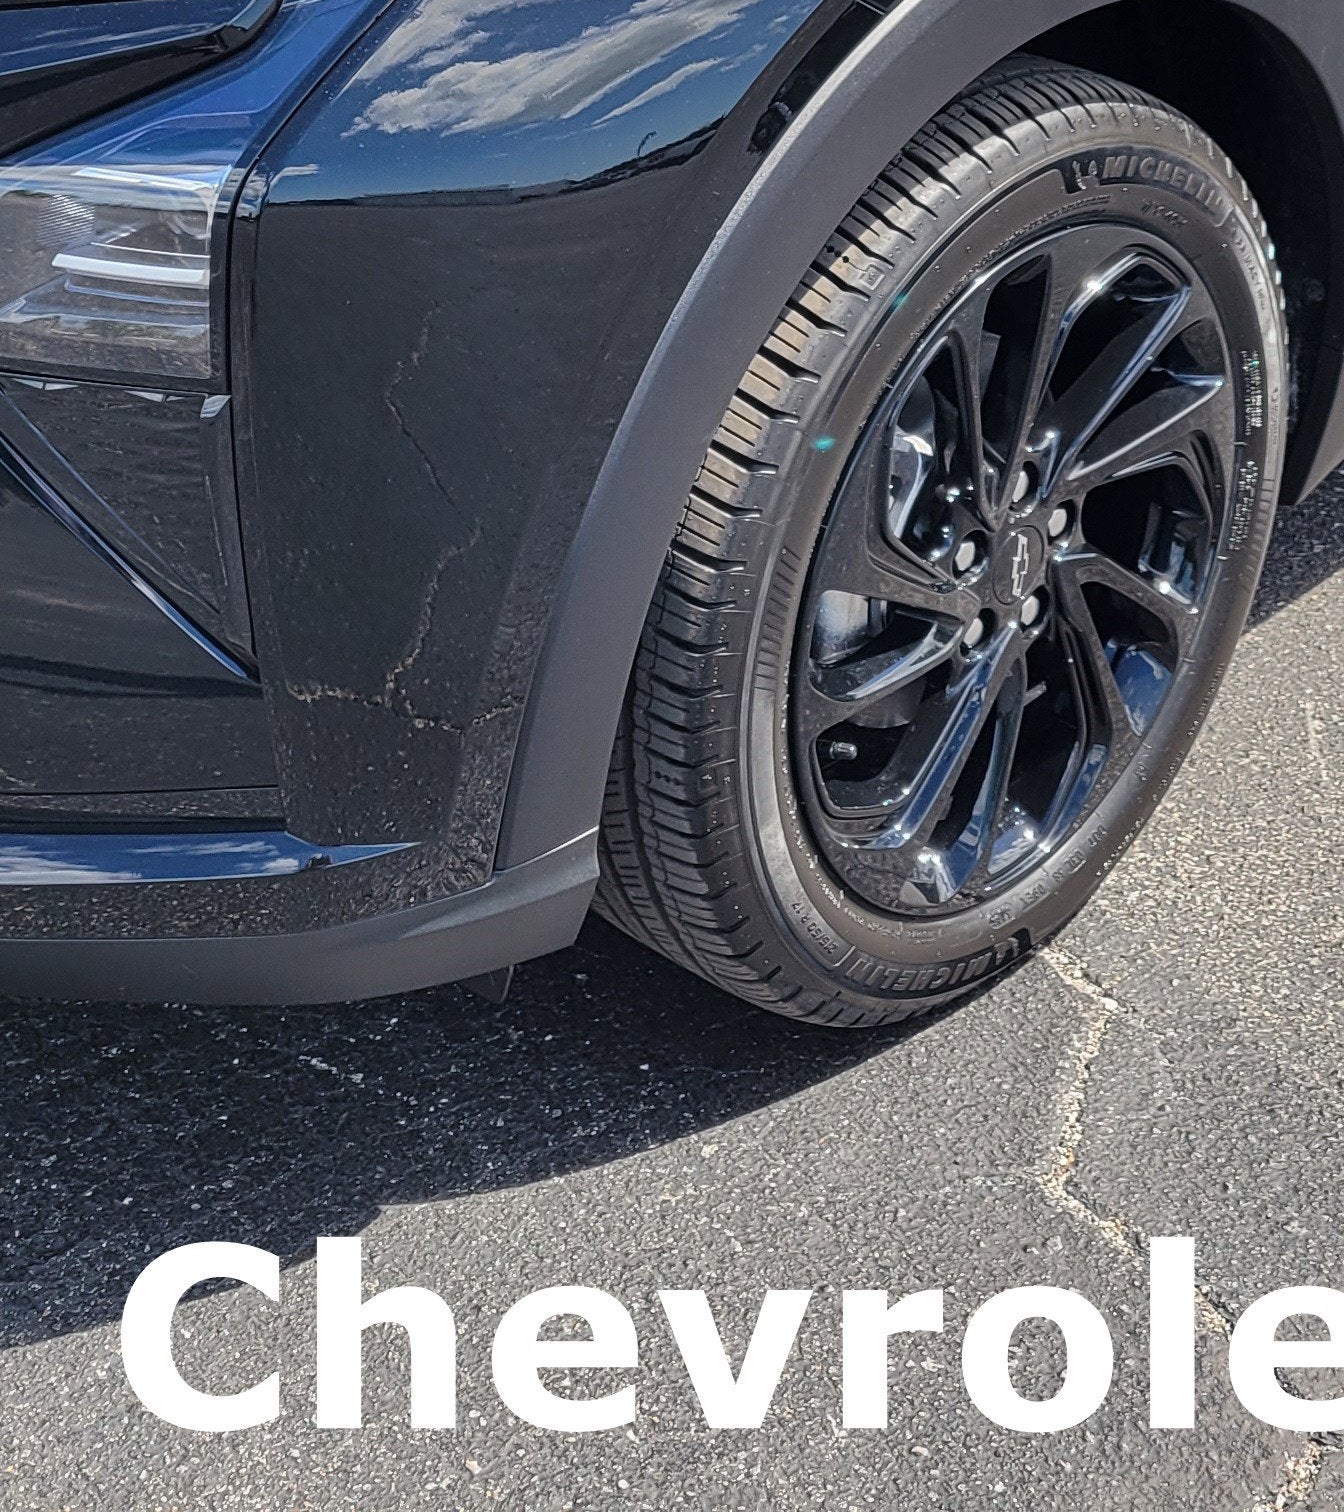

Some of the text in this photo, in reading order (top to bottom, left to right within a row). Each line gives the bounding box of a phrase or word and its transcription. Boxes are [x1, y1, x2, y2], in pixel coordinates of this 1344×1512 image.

[1102, 155, 1224, 210] MICHELIN
[807, 924, 840, 955] 215/50
[845, 951, 991, 992] MICHELIN
